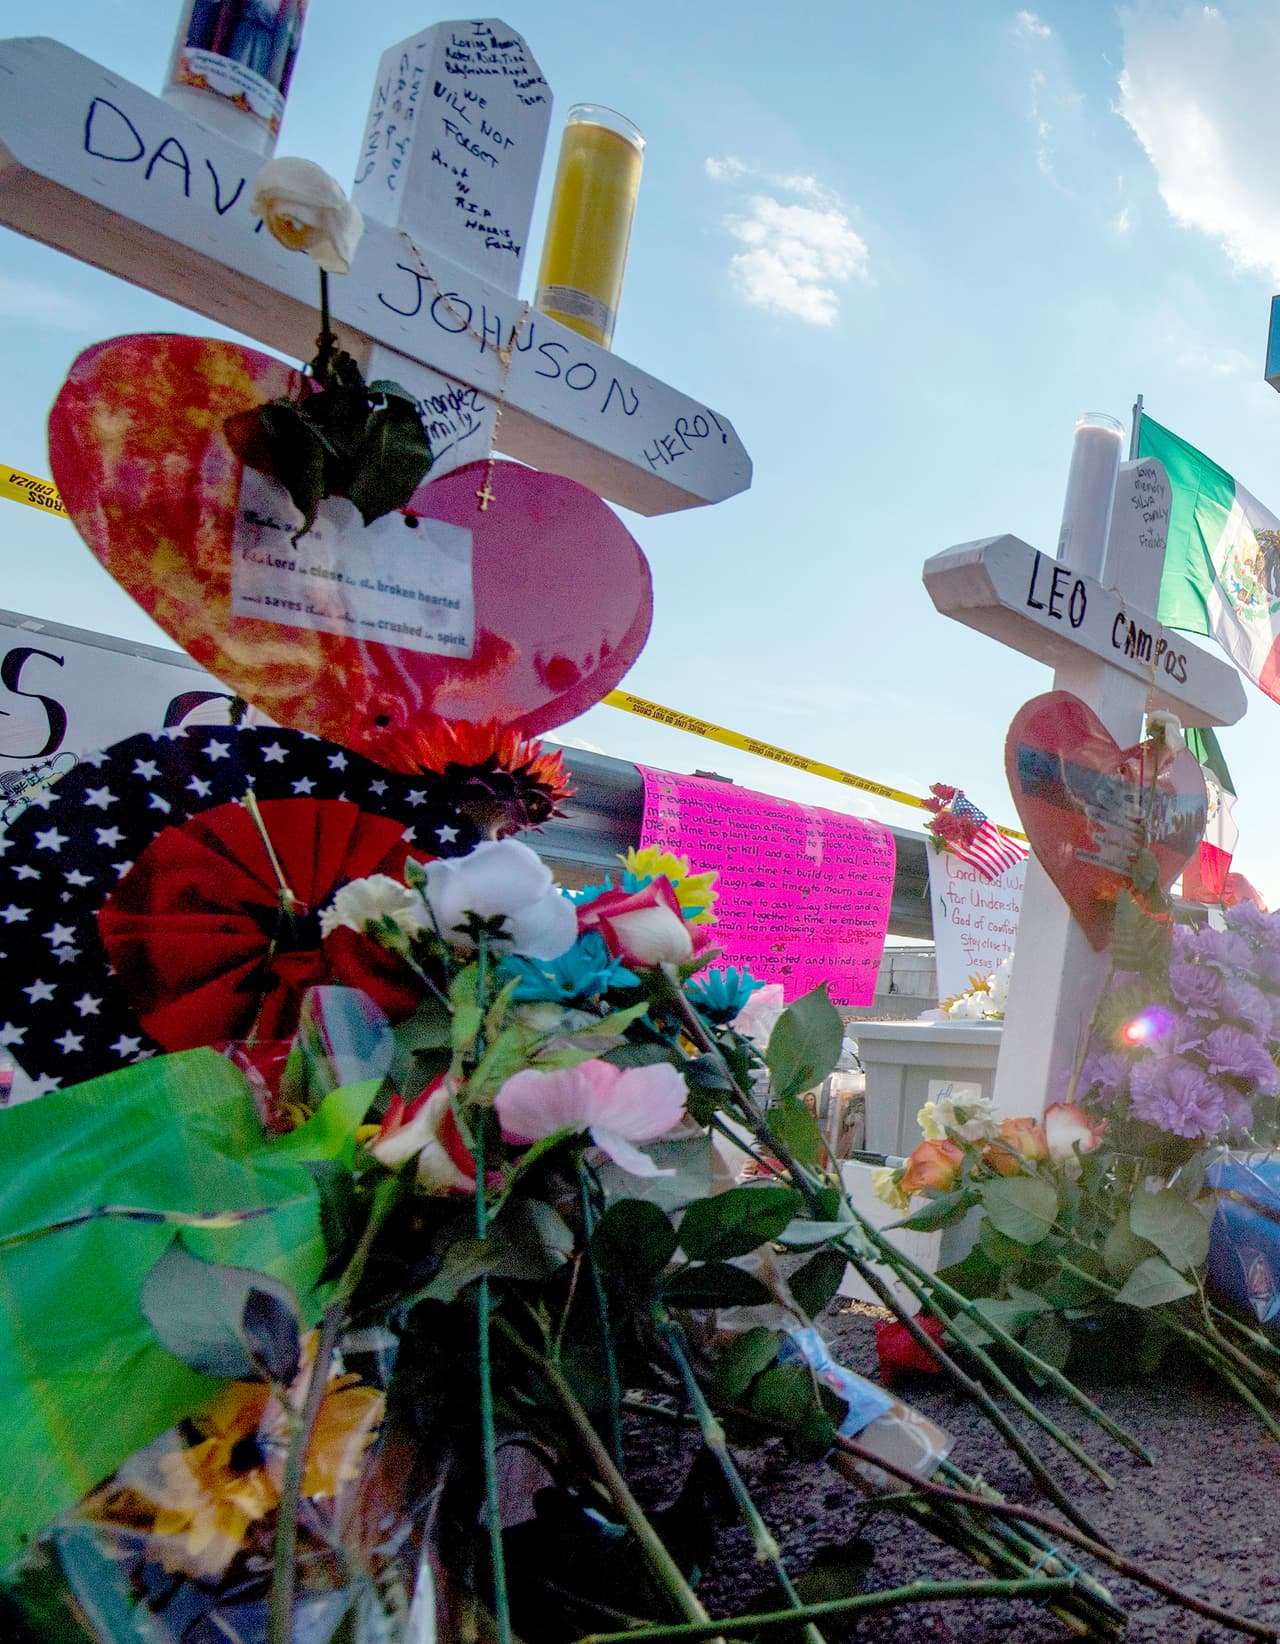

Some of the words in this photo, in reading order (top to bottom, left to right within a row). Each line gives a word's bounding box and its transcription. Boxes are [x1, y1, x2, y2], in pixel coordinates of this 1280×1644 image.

[463, 87, 488, 110] WE
[441, 117, 499, 169] FORGET
[480, 119, 516, 151] NOT
[84, 96, 264, 234] DAV
[377, 262, 639, 416] JOHNSON
[643, 408, 728, 471] HERO!
[8, 473, 55, 497] CRUZA
[266, 554, 296, 572] Lord
[310, 565, 344, 582] close
[377, 578, 416, 600] broken
[418, 589, 461, 611] hearted
[1026, 550, 1088, 629] LEO
[264, 596, 303, 612] saves
[376, 619, 423, 638] crushed
[437, 632, 470, 648] spirit.
[1112, 611, 1188, 685] CAMPOS
[632, 703, 652, 717] CROSS
[647, 787, 665, 801] For
[763, 809, 793, 821] season
[795, 815, 813, 825] and
[680, 823, 704, 836] time
[709, 828, 719, 837] to
[722, 829, 748, 841] plant
[752, 834, 769, 842] and
[692, 815, 723, 827] under
[699, 839, 723, 851] time
[727, 845, 738, 853] to
[741, 844, 760, 857] kill
[765, 850, 782, 859] and
[823, 854, 832, 864] to
[836, 854, 859, 866] heal
[862, 858, 869, 866] a
[873, 855, 891, 868] time
[699, 860, 724, 871] down
[727, 864, 745, 874] and
[757, 863, 779, 876] time
[783, 867, 793, 876] to
[797, 868, 822, 880] build
[848, 870, 868, 881] time
[946, 854, 977, 882] Lord
[720, 877, 748, 891] laugh
[857, 889, 874, 898] and
[946, 881, 967, 905] for
[713, 907, 746, 918] stones
[803, 914, 825, 925] time
[830, 916, 838, 924] to
[721, 898, 729, 906] a
[760, 899, 769, 908] to
[771, 901, 792, 910] cast
[855, 903, 871, 911] and
[769, 923, 815, 937] embracing
[952, 907, 971, 926] God
[973, 914, 985, 930] of
[960, 932, 980, 951] Stay
[721, 951, 758, 963] broken
[759, 952, 801, 964] hearted
[805, 954, 825, 965] and
[963, 948, 993, 969] Jesus
[803, 975, 840, 994] Pao
